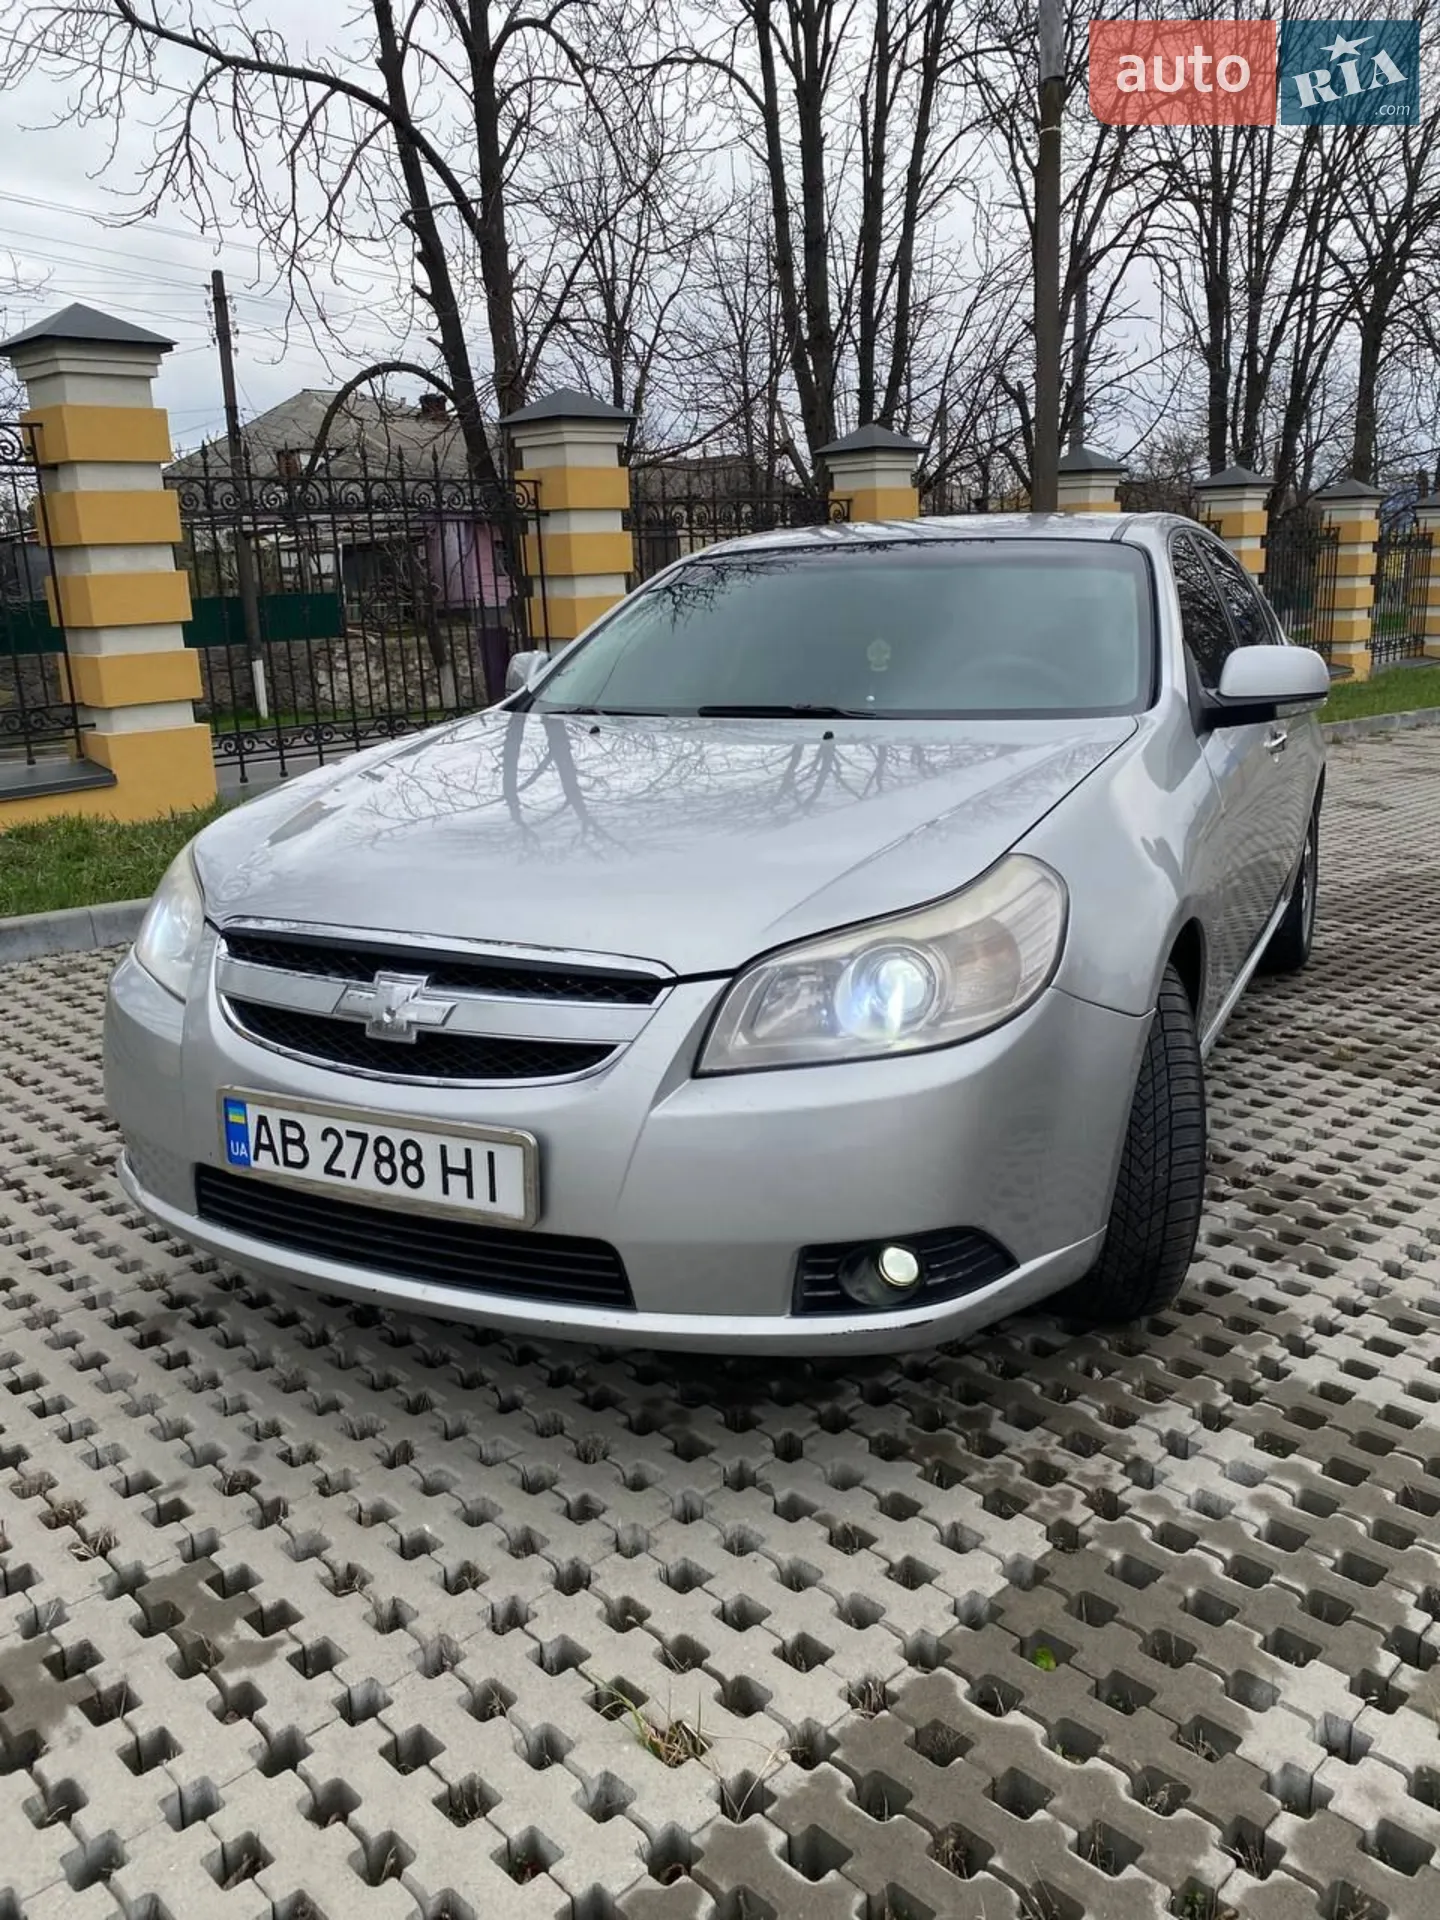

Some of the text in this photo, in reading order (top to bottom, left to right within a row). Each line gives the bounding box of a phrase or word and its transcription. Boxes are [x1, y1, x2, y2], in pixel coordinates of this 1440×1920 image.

[230, 1140, 249, 1157] UA
[252, 1114, 497, 1203] AB 2788 HI
